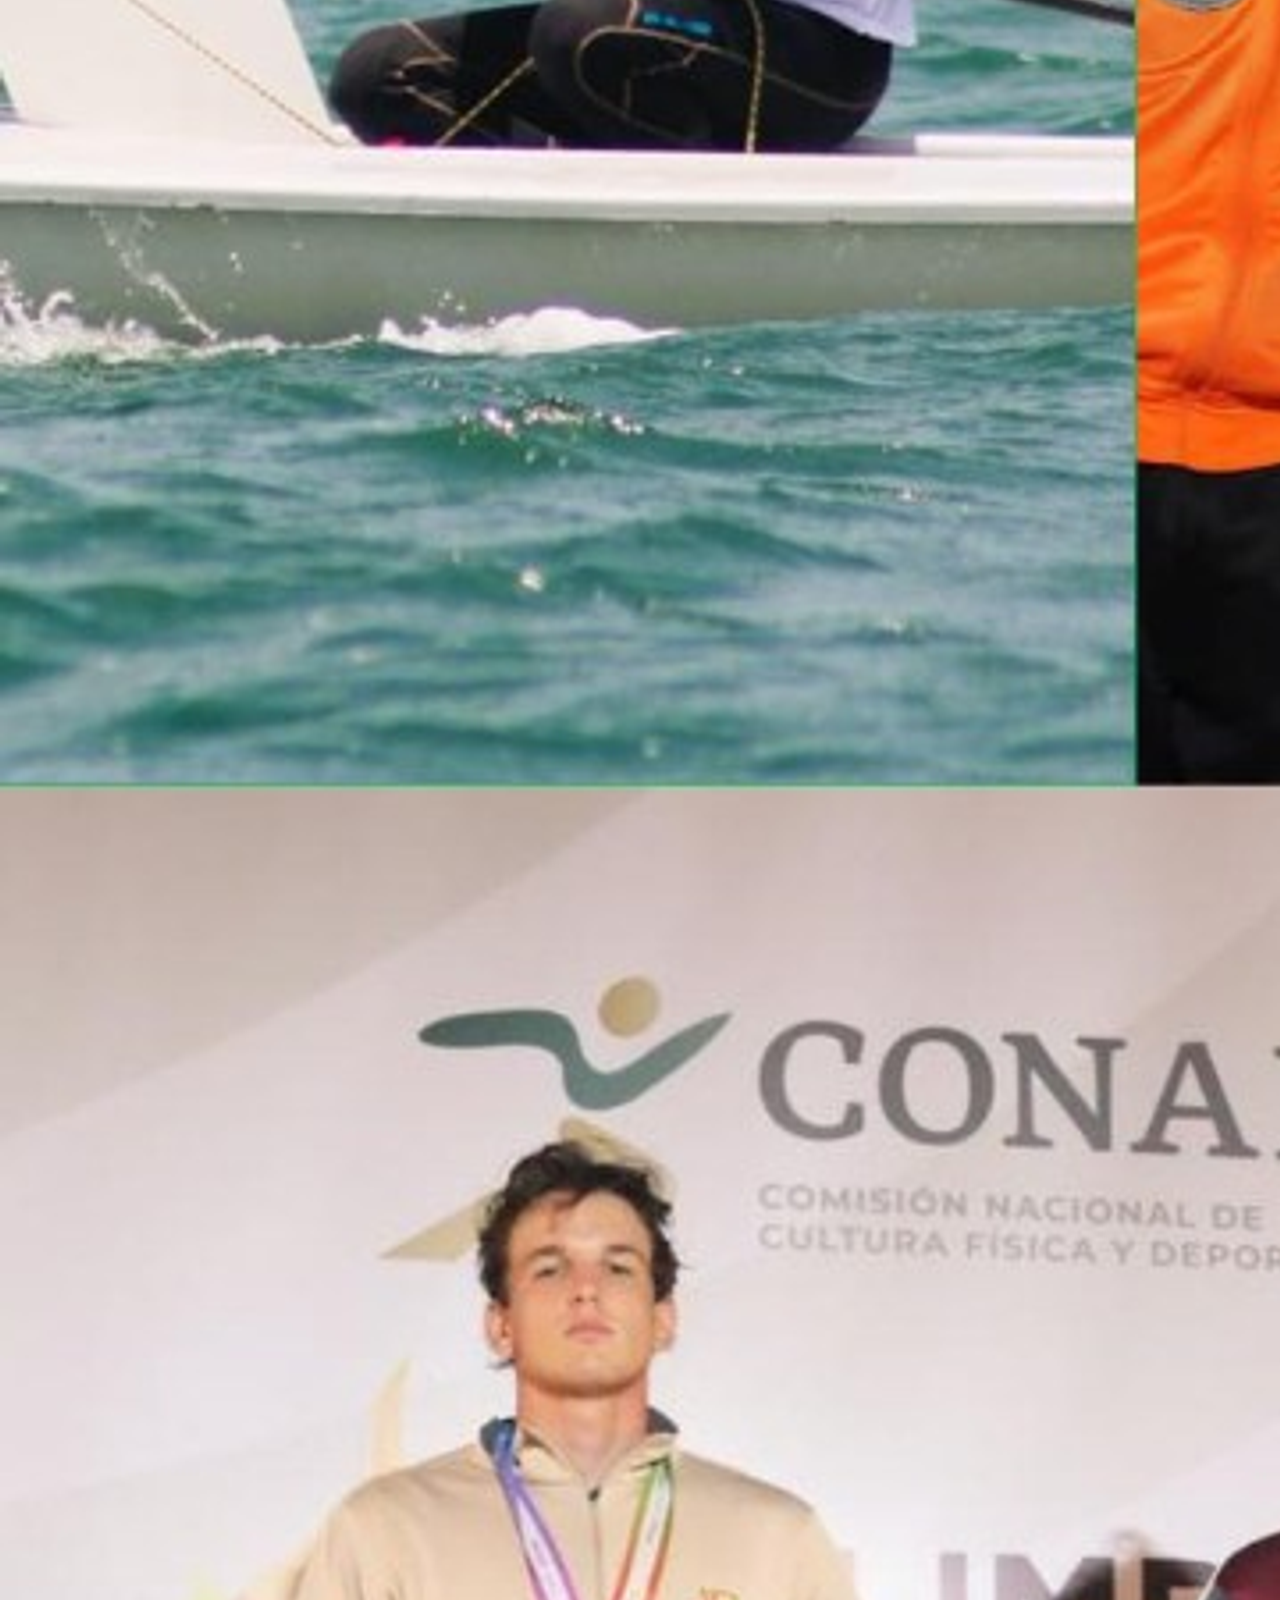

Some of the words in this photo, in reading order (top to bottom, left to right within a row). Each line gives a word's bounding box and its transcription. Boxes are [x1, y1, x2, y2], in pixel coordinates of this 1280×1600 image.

[757, 1183, 969, 1218] COMISIÓN
[984, 1194, 1195, 1229] NACIONAL
[1211, 1203, 1264, 1231] DE
[757, 1223, 950, 1258] CULTURA
[966, 1229, 1098, 1264] FÍSICA
[1110, 1239, 1138, 1266] Y
